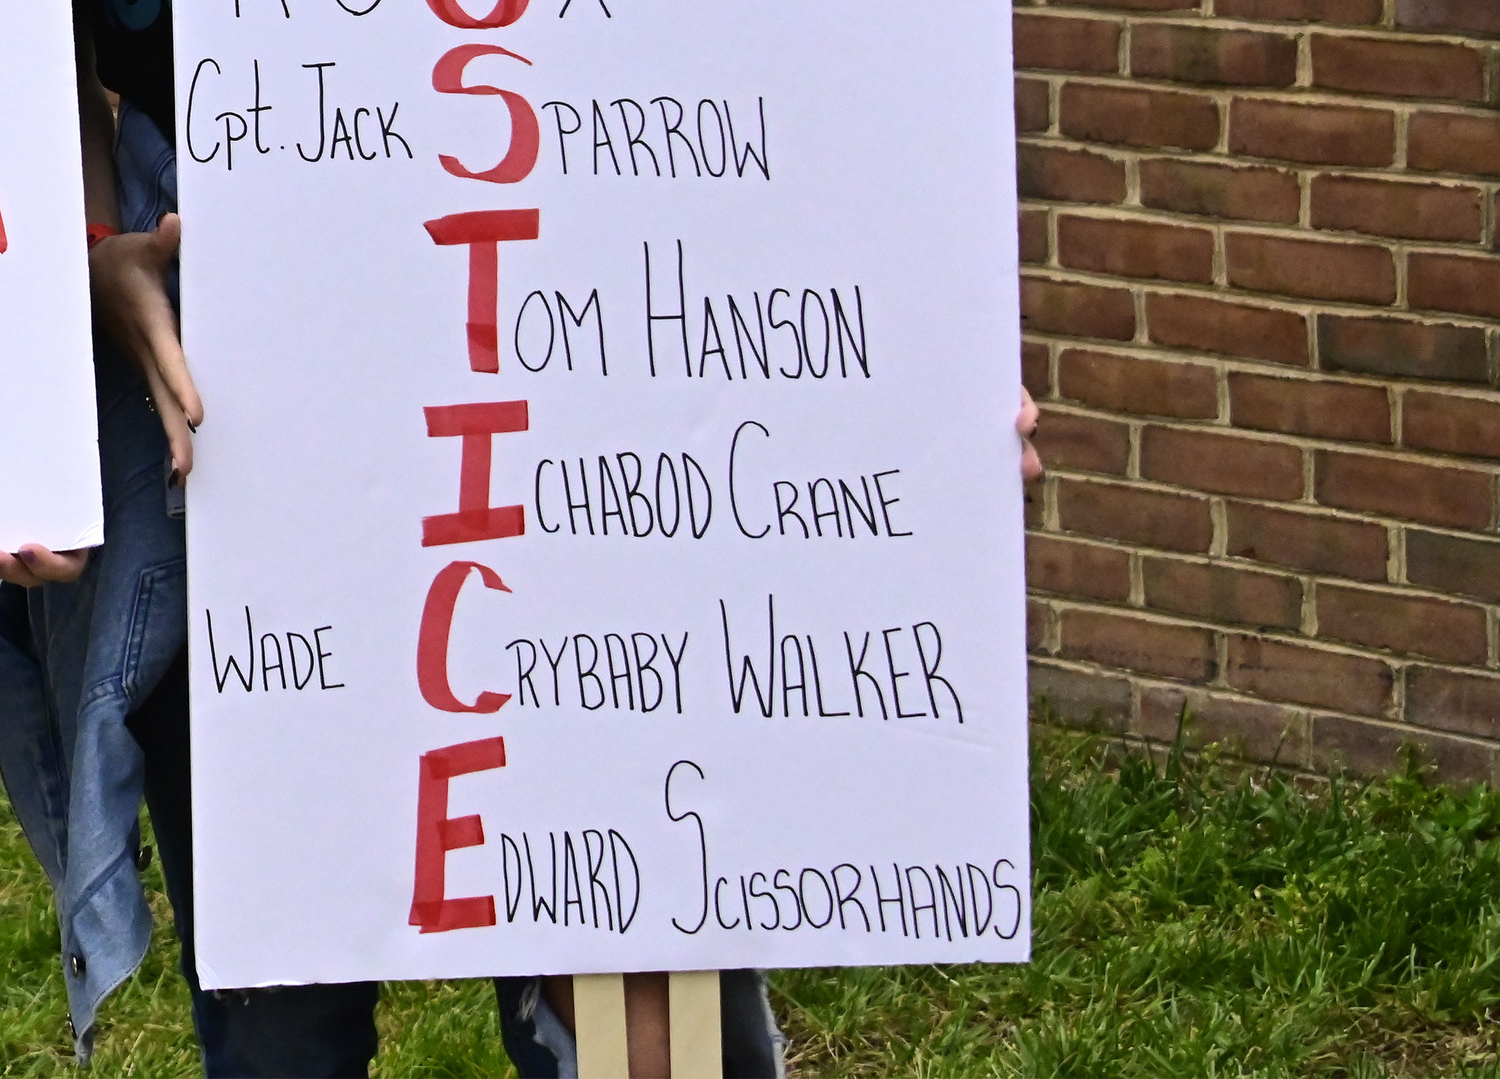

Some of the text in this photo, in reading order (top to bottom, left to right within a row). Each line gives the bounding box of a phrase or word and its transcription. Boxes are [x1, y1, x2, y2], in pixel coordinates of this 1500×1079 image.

[296, 62, 413, 162] JACK
[432, 44, 770, 184] SPARROW
[423, 208, 870, 380] TOM HANSON
[421, 400, 913, 547] ICHABOD CRANE
[206, 561, 963, 724] WADE CRYBABY WALKER
[408, 736, 1021, 942] EDWARD SCISSORHANDS
